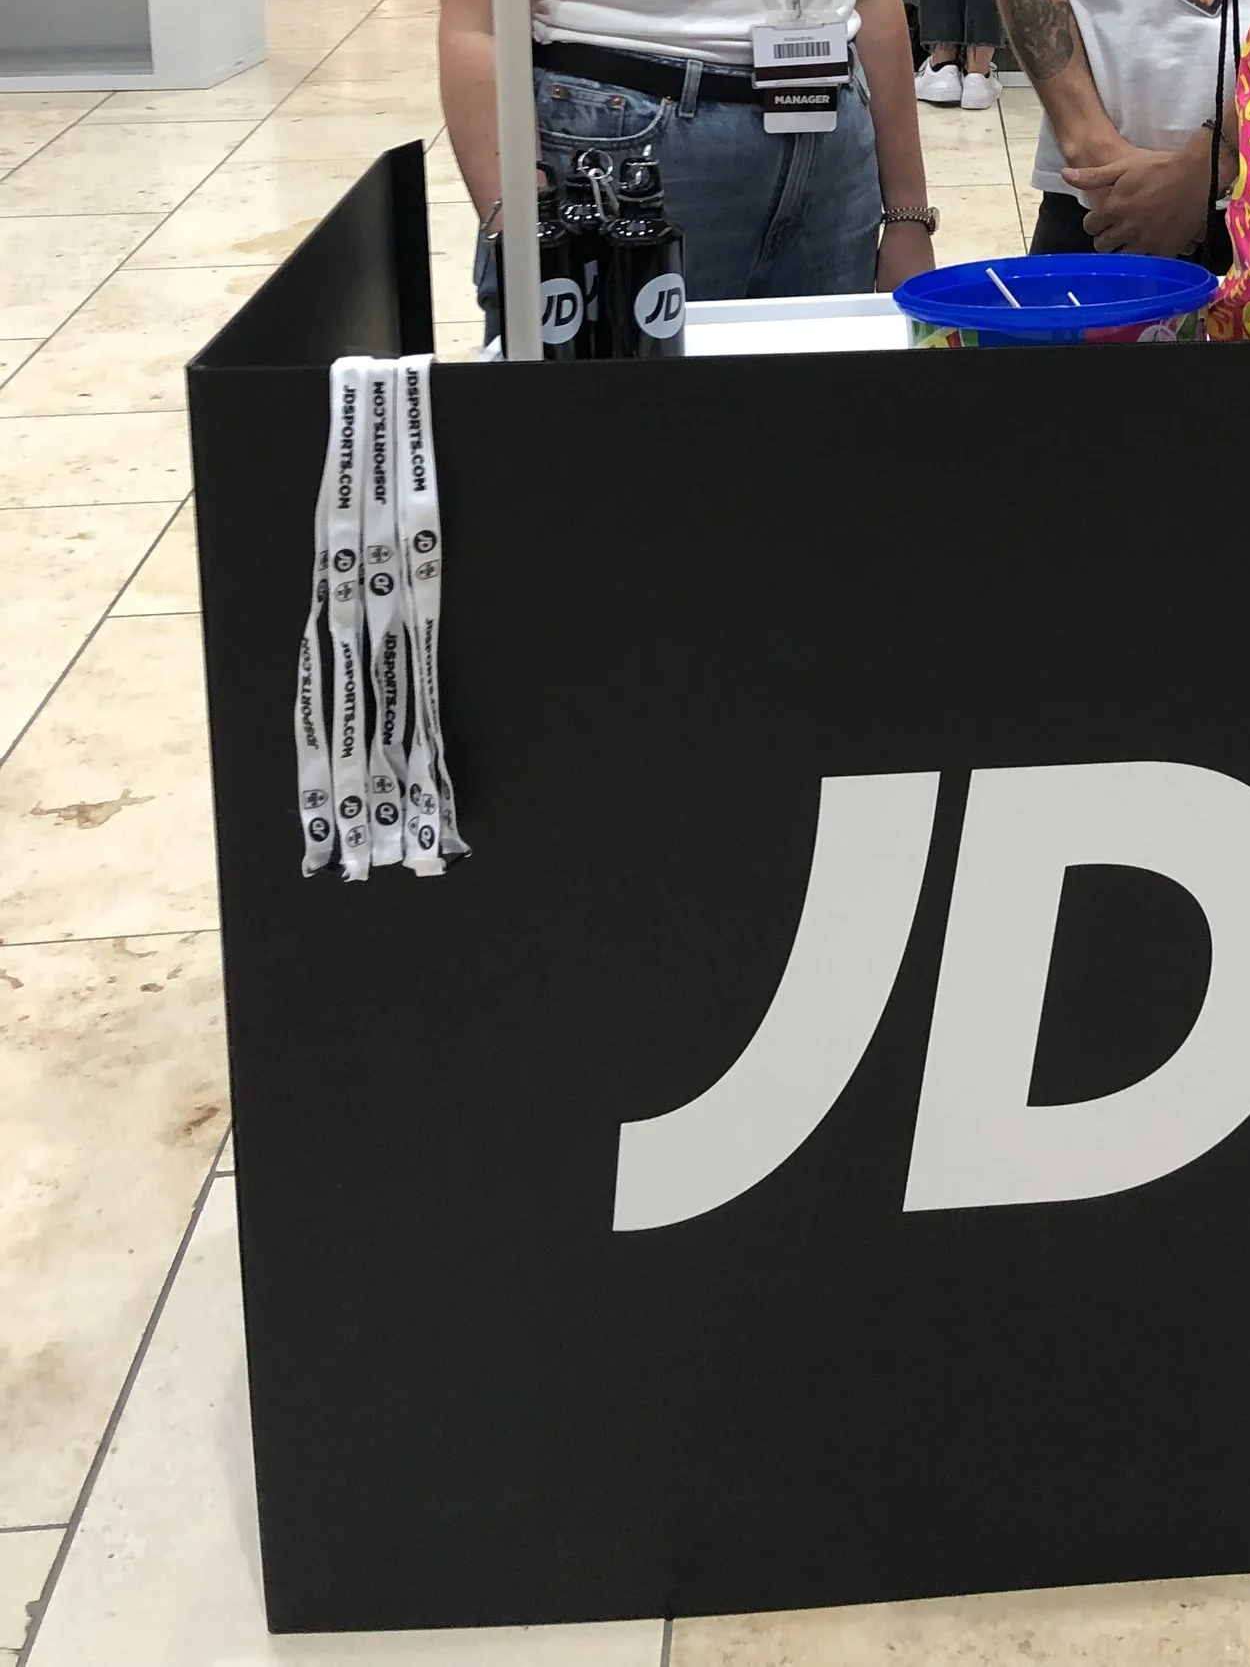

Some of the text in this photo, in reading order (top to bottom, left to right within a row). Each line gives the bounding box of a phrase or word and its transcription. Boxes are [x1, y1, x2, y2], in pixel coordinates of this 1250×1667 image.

[774, 94, 830, 105] MANAGER
[1235, 216, 1245, 238] I
[542, 292, 578, 327] JD
[645, 287, 683, 325] JD
[338, 385, 356, 510] JDSPORTS.COM
[372, 381, 387, 505] JDSPORTS.COM
[406, 367, 426, 492] JDSPORTS.COM
[340, 641, 356, 758] JDSPORTS.COM
[382, 631, 398, 745] JDSPORTS.COM
